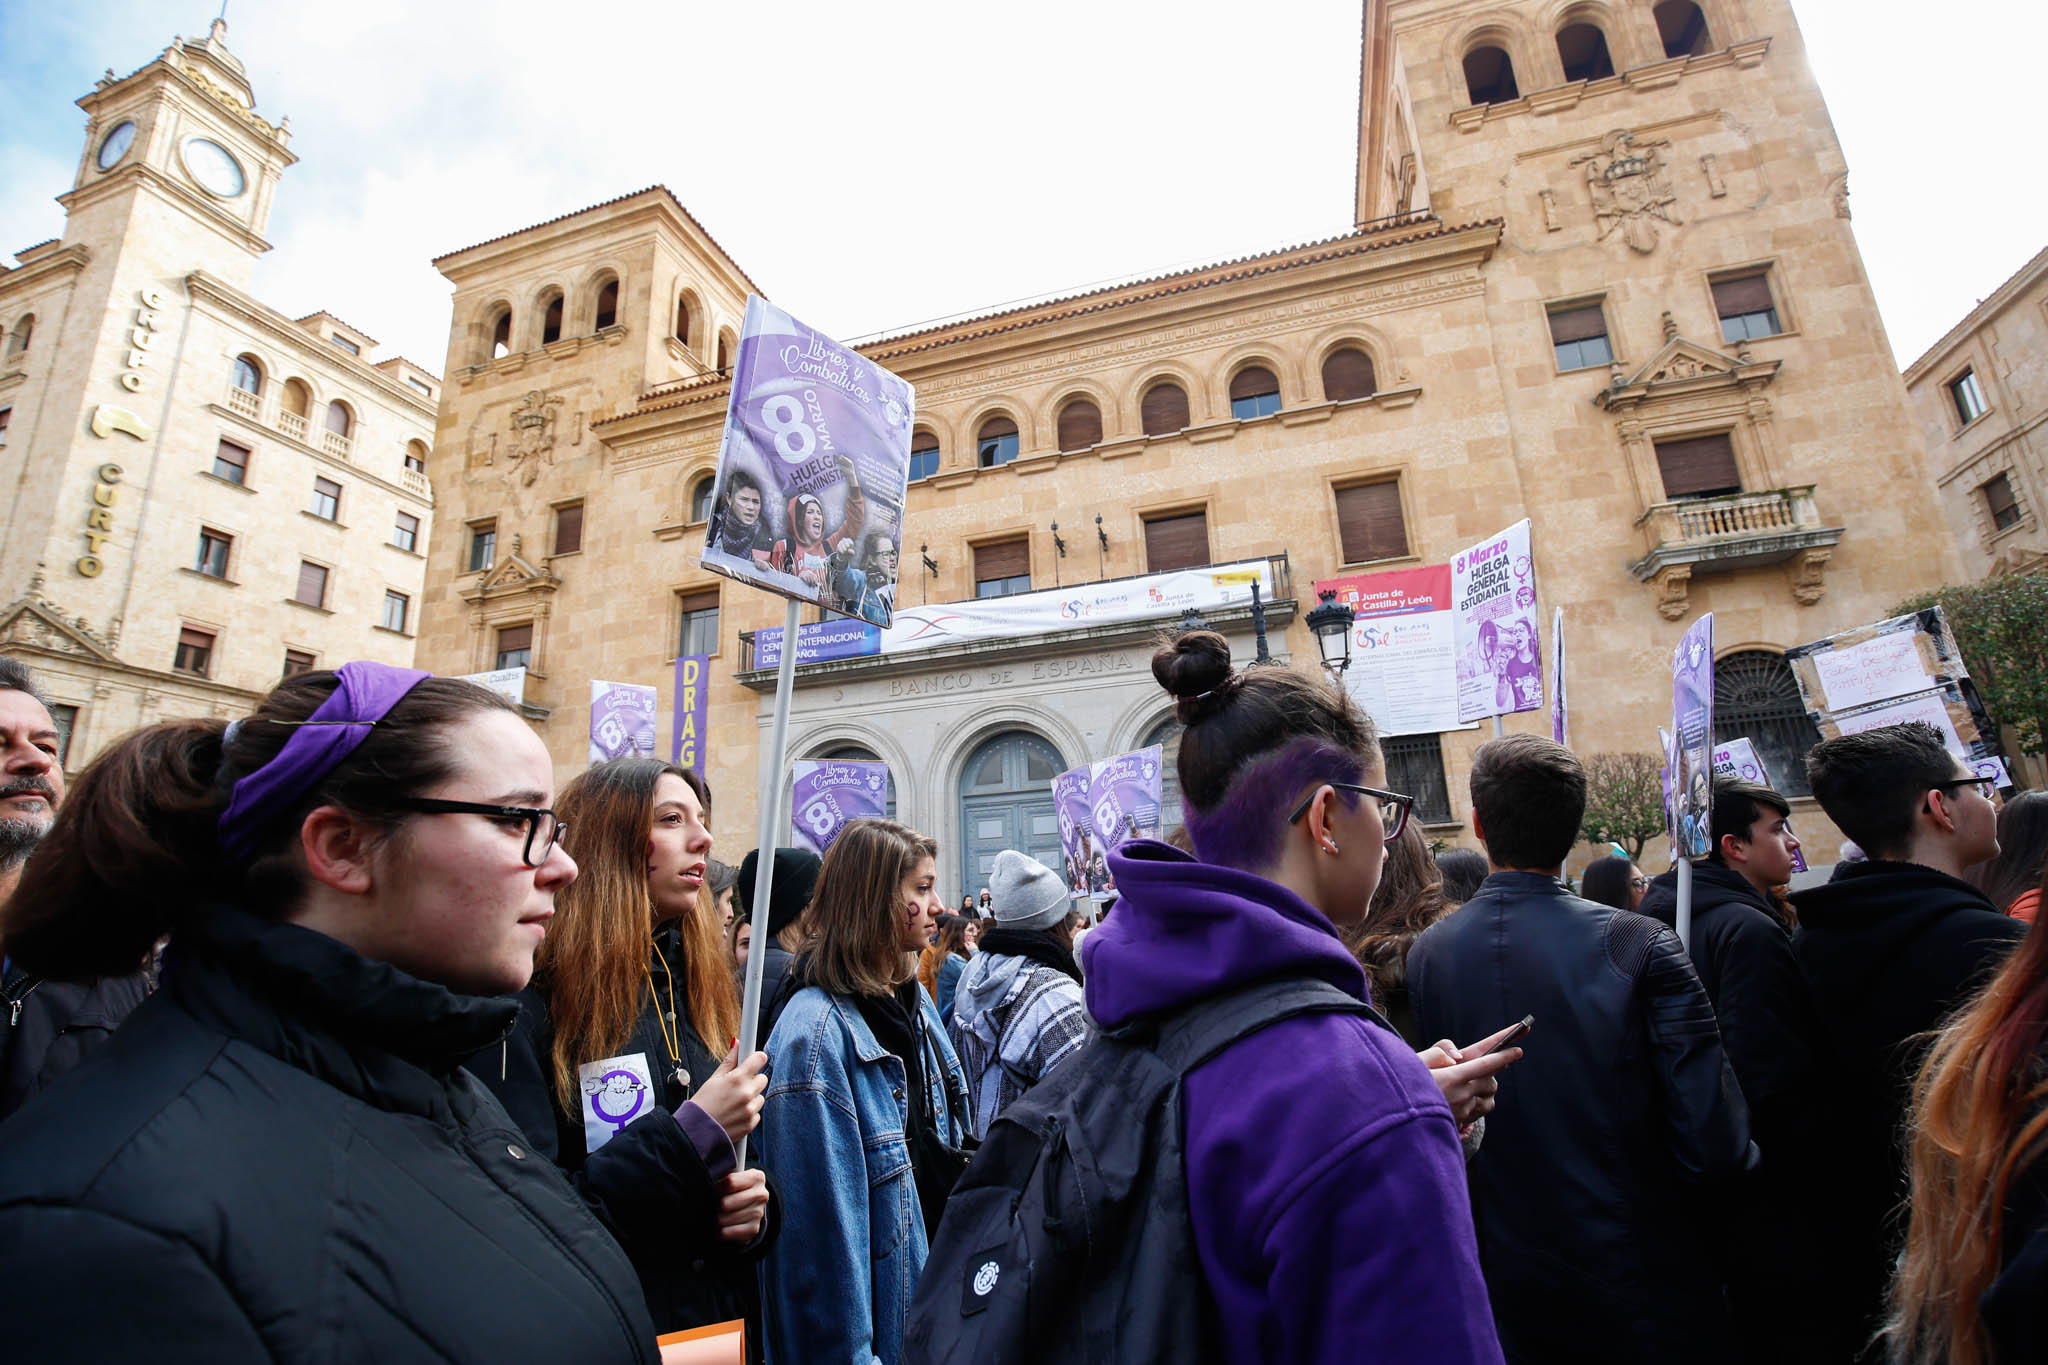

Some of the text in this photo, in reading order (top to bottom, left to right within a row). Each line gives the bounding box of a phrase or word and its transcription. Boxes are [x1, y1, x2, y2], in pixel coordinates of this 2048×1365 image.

[122, 287, 163, 393] GRUPO
[800, 332, 864, 381] Libres y
[780, 344, 872, 403] Combativas
[761, 394, 817, 464] 8
[804, 389, 836, 451] MARZO
[790, 454, 843, 486] HUELGA
[77, 463, 124, 578] CURTO
[1456, 539, 1509, 575] 8 Marzo
[1471, 554, 1510, 582] HUELGA
[1362, 589, 1404, 601] Junta de
[1460, 581, 1511, 612] ESTUDIANTIL
[1467, 567, 1510, 597] GENERAL
[1362, 595, 1433, 610] Castilla y León
[798, 630, 869, 648] INTERNACIONAL
[809, 624, 822, 634] del
[762, 649, 820, 664] DEL AÑOL
[888, 652, 1134, 697] BANCO DE ESPAÑA
[680, 659, 700, 768] DRAG
[600, 720, 622, 750] 8
[811, 774, 862, 791] Combativas
[805, 801, 835, 835] 8
[825, 793, 845, 821] MARZO
[1097, 801, 1117, 836] 8
[1062, 814, 1073, 844] 8
